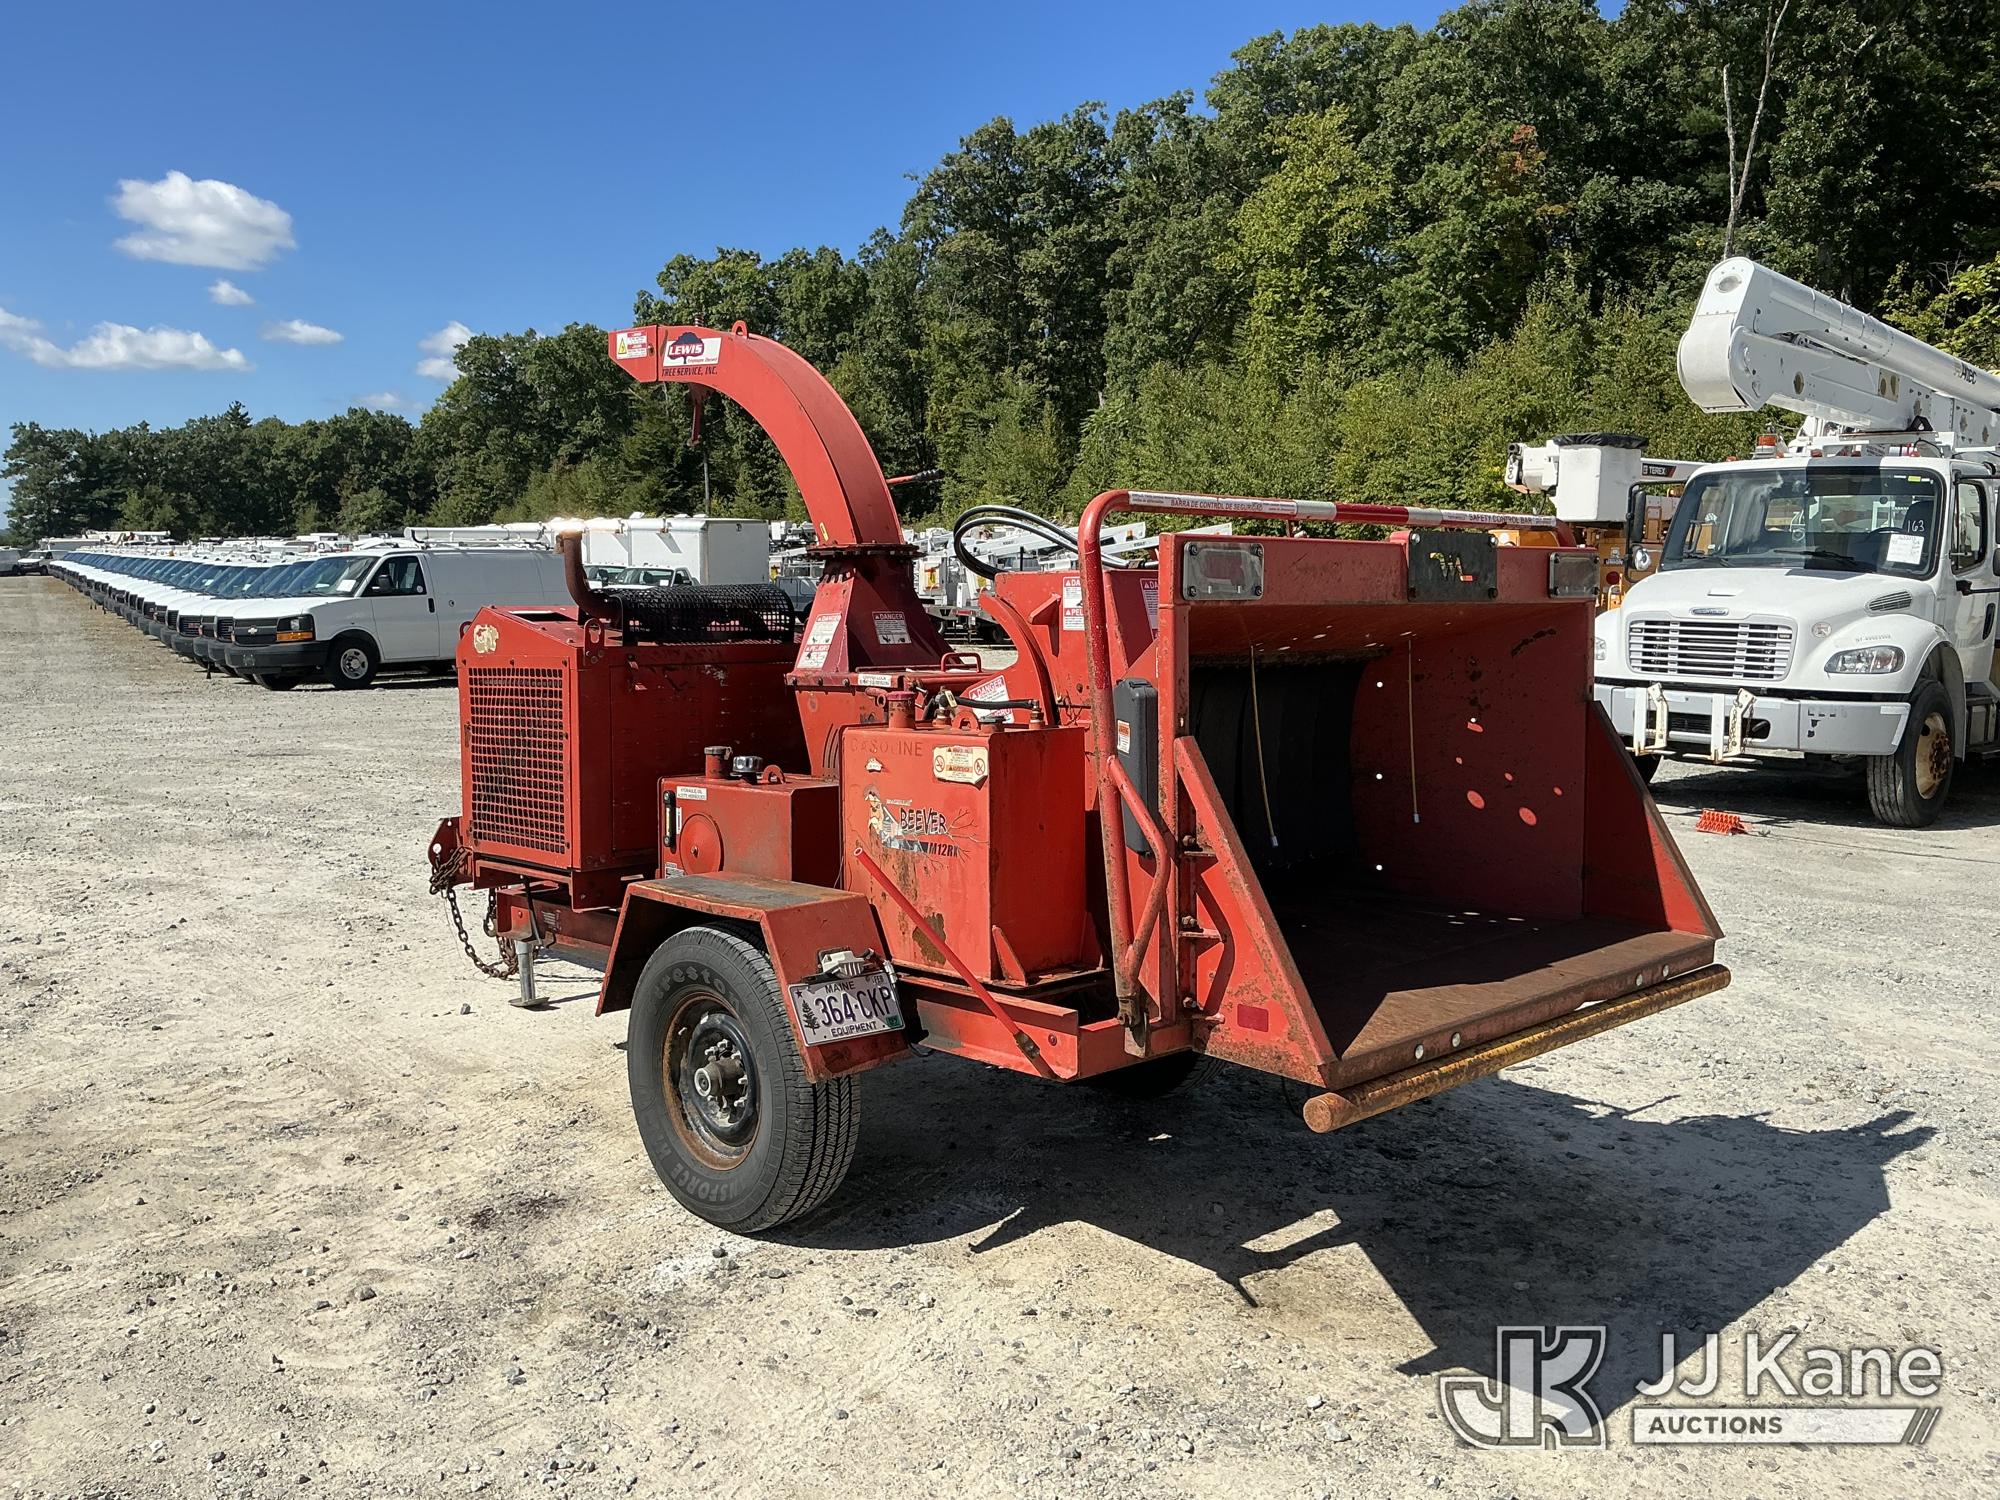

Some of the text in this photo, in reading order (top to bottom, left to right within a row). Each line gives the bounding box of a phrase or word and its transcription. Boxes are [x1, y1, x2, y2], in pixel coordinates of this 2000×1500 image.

[669, 344, 703, 356] LEWIS
[662, 368, 676, 377] TREE
[676, 367, 703, 377] SERVICE,
[1648, 466, 1666, 475] TEREX
[1170, 499, 1190, 508] BARRA
[1190, 500, 1198, 508] DE
[1200, 501, 1224, 510] CONTROL
[1225, 502, 1233, 510] DE
[1469, 513, 1492, 522] SAFETY
[1492, 515, 1519, 524] CONTROL
[1907, 519, 1925, 533] 163
[976, 677, 1004, 697] DANGER
[900, 807, 947, 835] BEEVER
[824, 981, 856, 993] MAINE
[831, 1021, 878, 1038] EQUIPMENT
